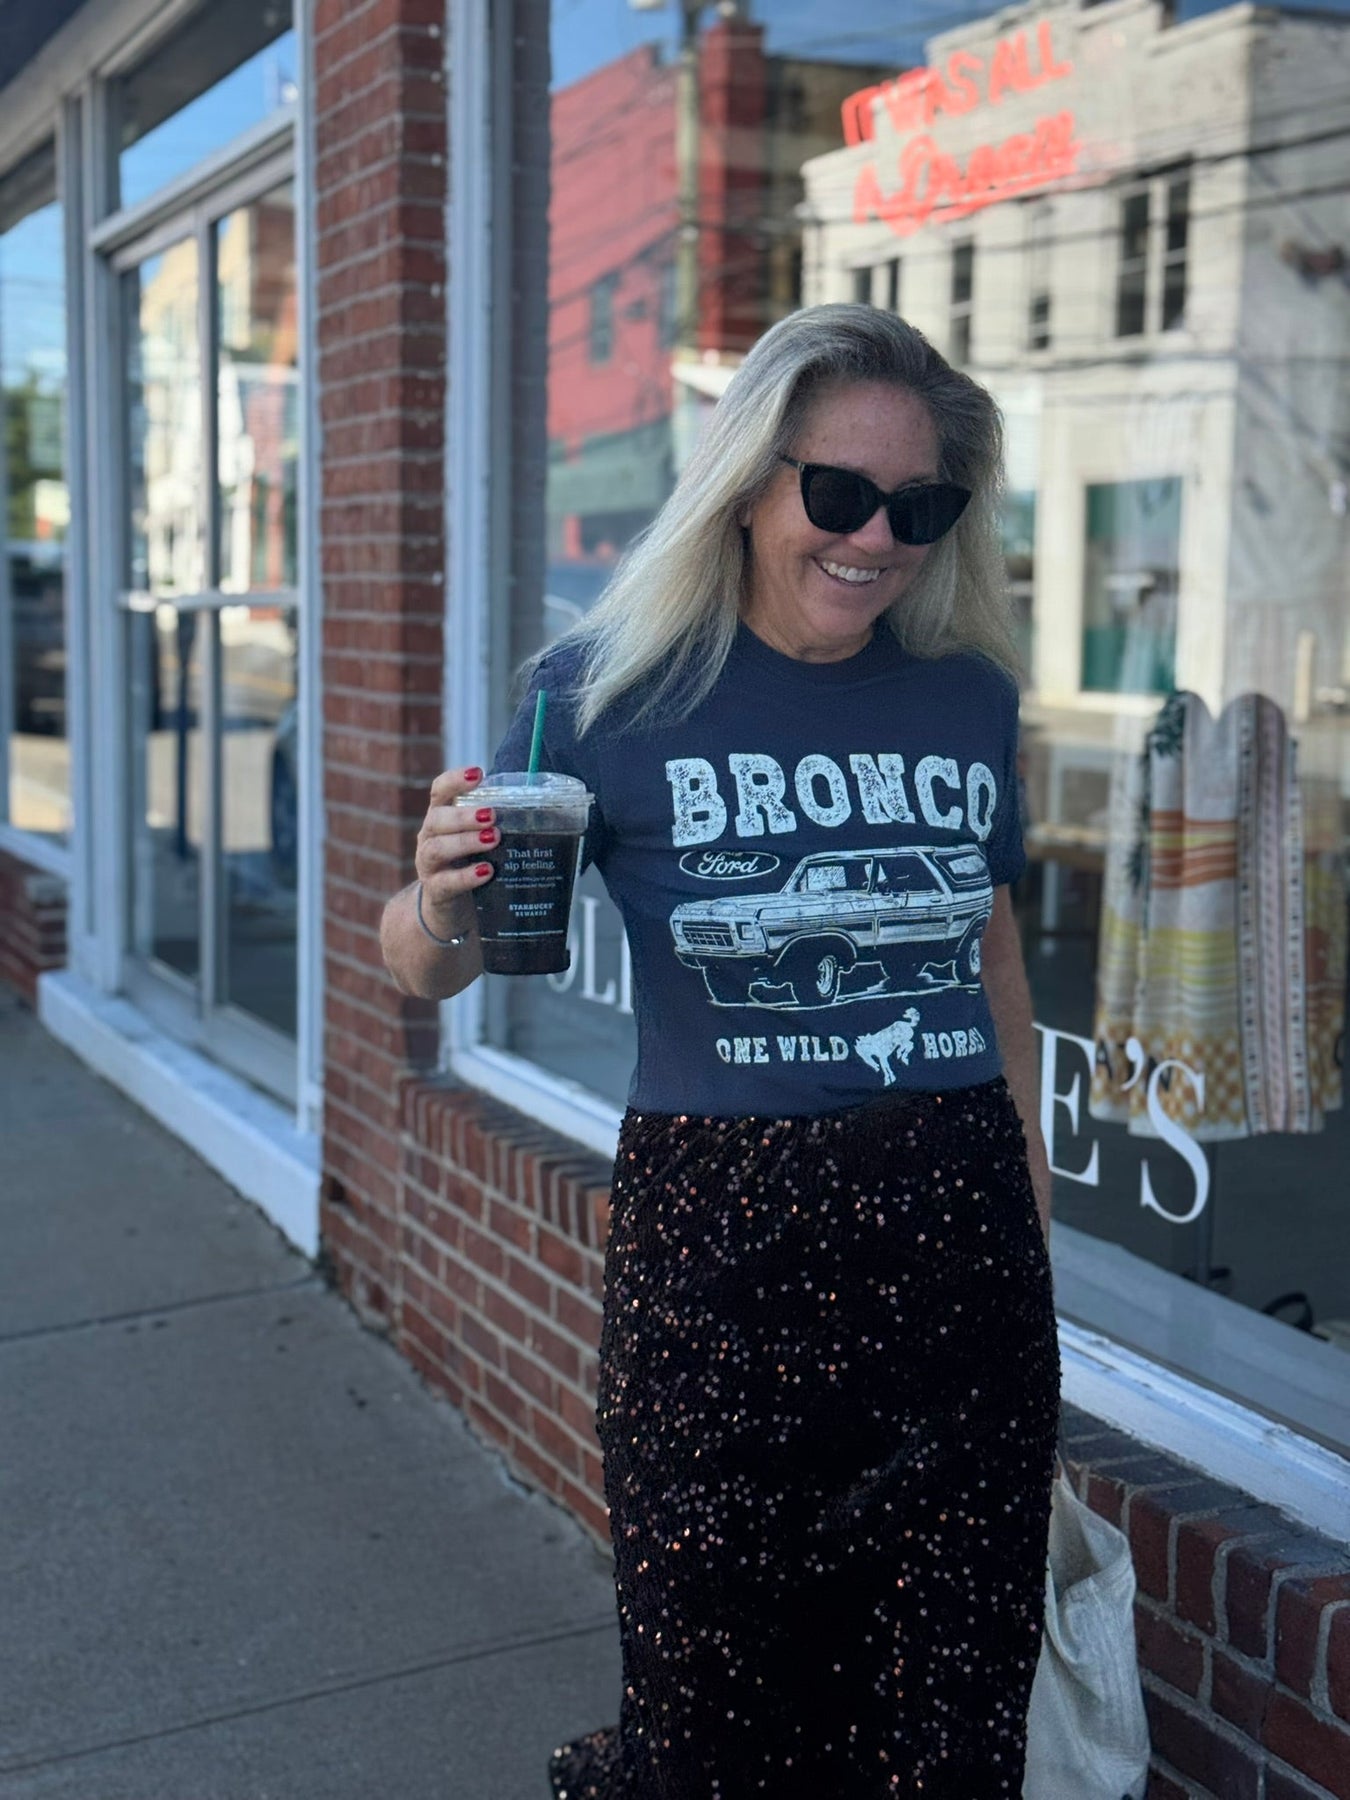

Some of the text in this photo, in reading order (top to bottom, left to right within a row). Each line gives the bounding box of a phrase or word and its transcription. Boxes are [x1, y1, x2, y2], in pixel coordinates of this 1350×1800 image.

[989, 20, 1073, 105] ALL
[665, 753, 996, 843] BRONCO
[507, 848, 553, 858] That first
[698, 851, 759, 875] Ford
[504, 861, 520, 872] sip
[715, 1037, 770, 1064] ONE
[776, 1035, 850, 1062] WILD
